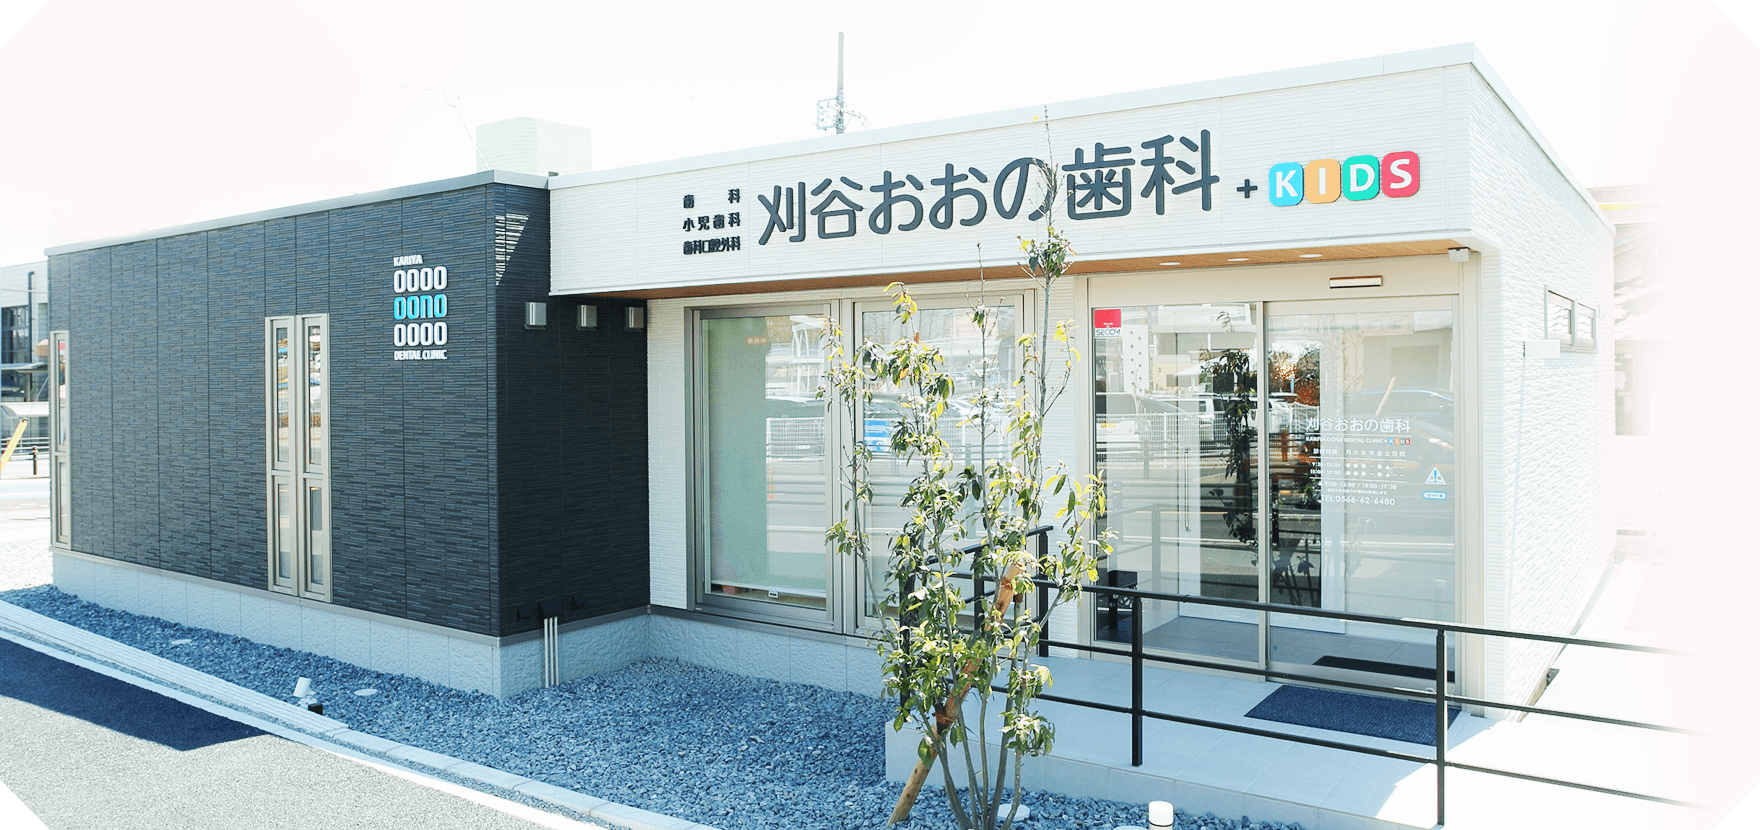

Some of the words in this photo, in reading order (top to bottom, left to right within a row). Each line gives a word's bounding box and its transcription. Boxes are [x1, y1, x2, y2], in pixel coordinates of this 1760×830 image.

[758, 129, 1220, 246] 刈谷おおの歯科
[1273, 156, 1415, 201] KIDS
[682, 212, 741, 232] 小児歯科
[393, 254, 423, 267] KARIYA
[1096, 328, 1121, 336] SECOM
[394, 350, 422, 361] DENTAL
[422, 349, 448, 360] CLINIC
[1305, 417, 1411, 434] 刈谷おおの歯科
[1335, 495, 1396, 506] 0566-62-6480
